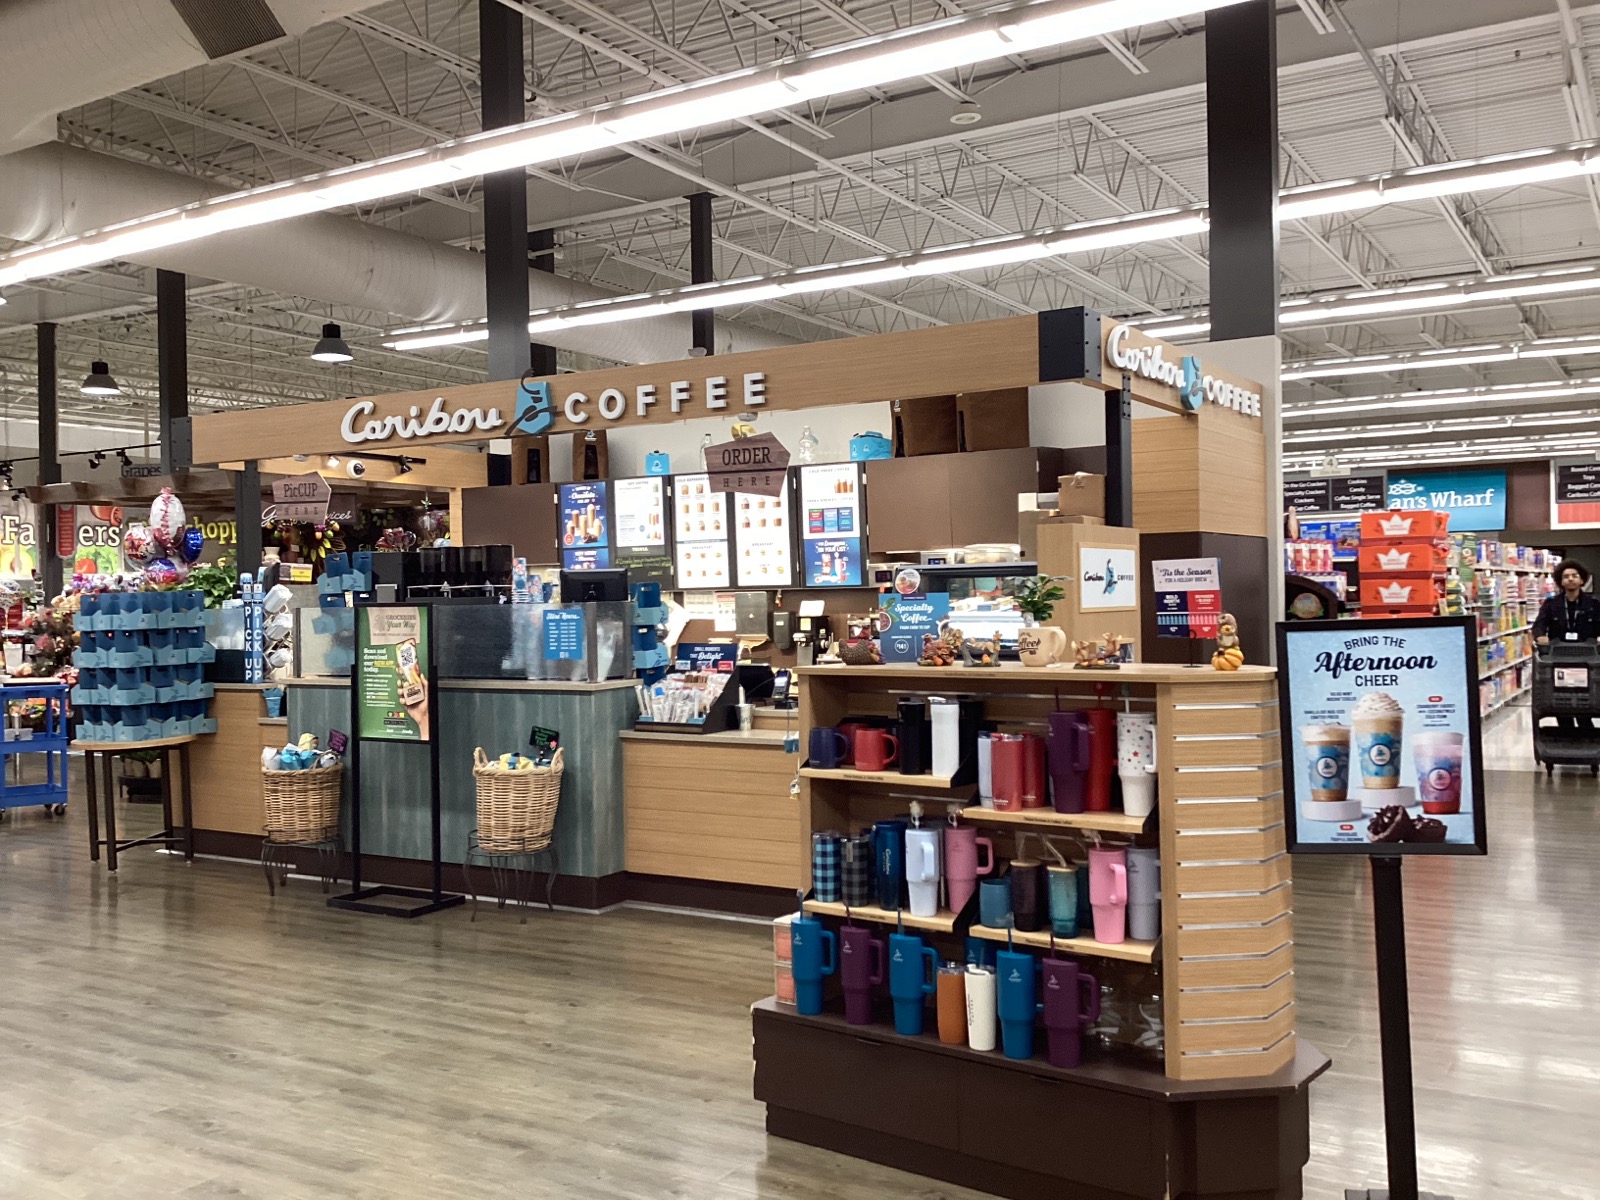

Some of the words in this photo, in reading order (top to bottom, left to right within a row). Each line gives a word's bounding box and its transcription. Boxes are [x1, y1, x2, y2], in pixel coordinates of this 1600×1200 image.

[1107, 324, 1187, 388] Caribou
[1202, 374, 1261, 417] COFFEE
[340, 397, 505, 443] Caribou
[564, 371, 766, 424] COFFEE
[722, 446, 772, 466] ORDER
[723, 475, 771, 488] HERE
[1389, 495, 1428, 510] an's
[1430, 488, 1495, 508] Wharf
[326, 510, 353, 520] vices
[2, 515, 37, 546] Fa
[1083, 571, 1104, 582] Caribou
[1174, 568, 1184, 576] the
[1187, 567, 1212, 576] Season
[894, 603, 934, 614] Specialty
[403, 620, 417, 632] Way
[900, 613, 933, 624] Coffee
[244, 606, 253, 652] PICK
[254, 606, 262, 652] PICK
[1344, 635, 1380, 650] BRING
[1383, 635, 1407, 649] THE
[698, 651, 725, 662] Delight
[1313, 651, 1438, 679] Afternoon
[244, 658, 253, 681] UP
[254, 658, 262, 680] UP
[1354, 674, 1399, 687] CHEER
